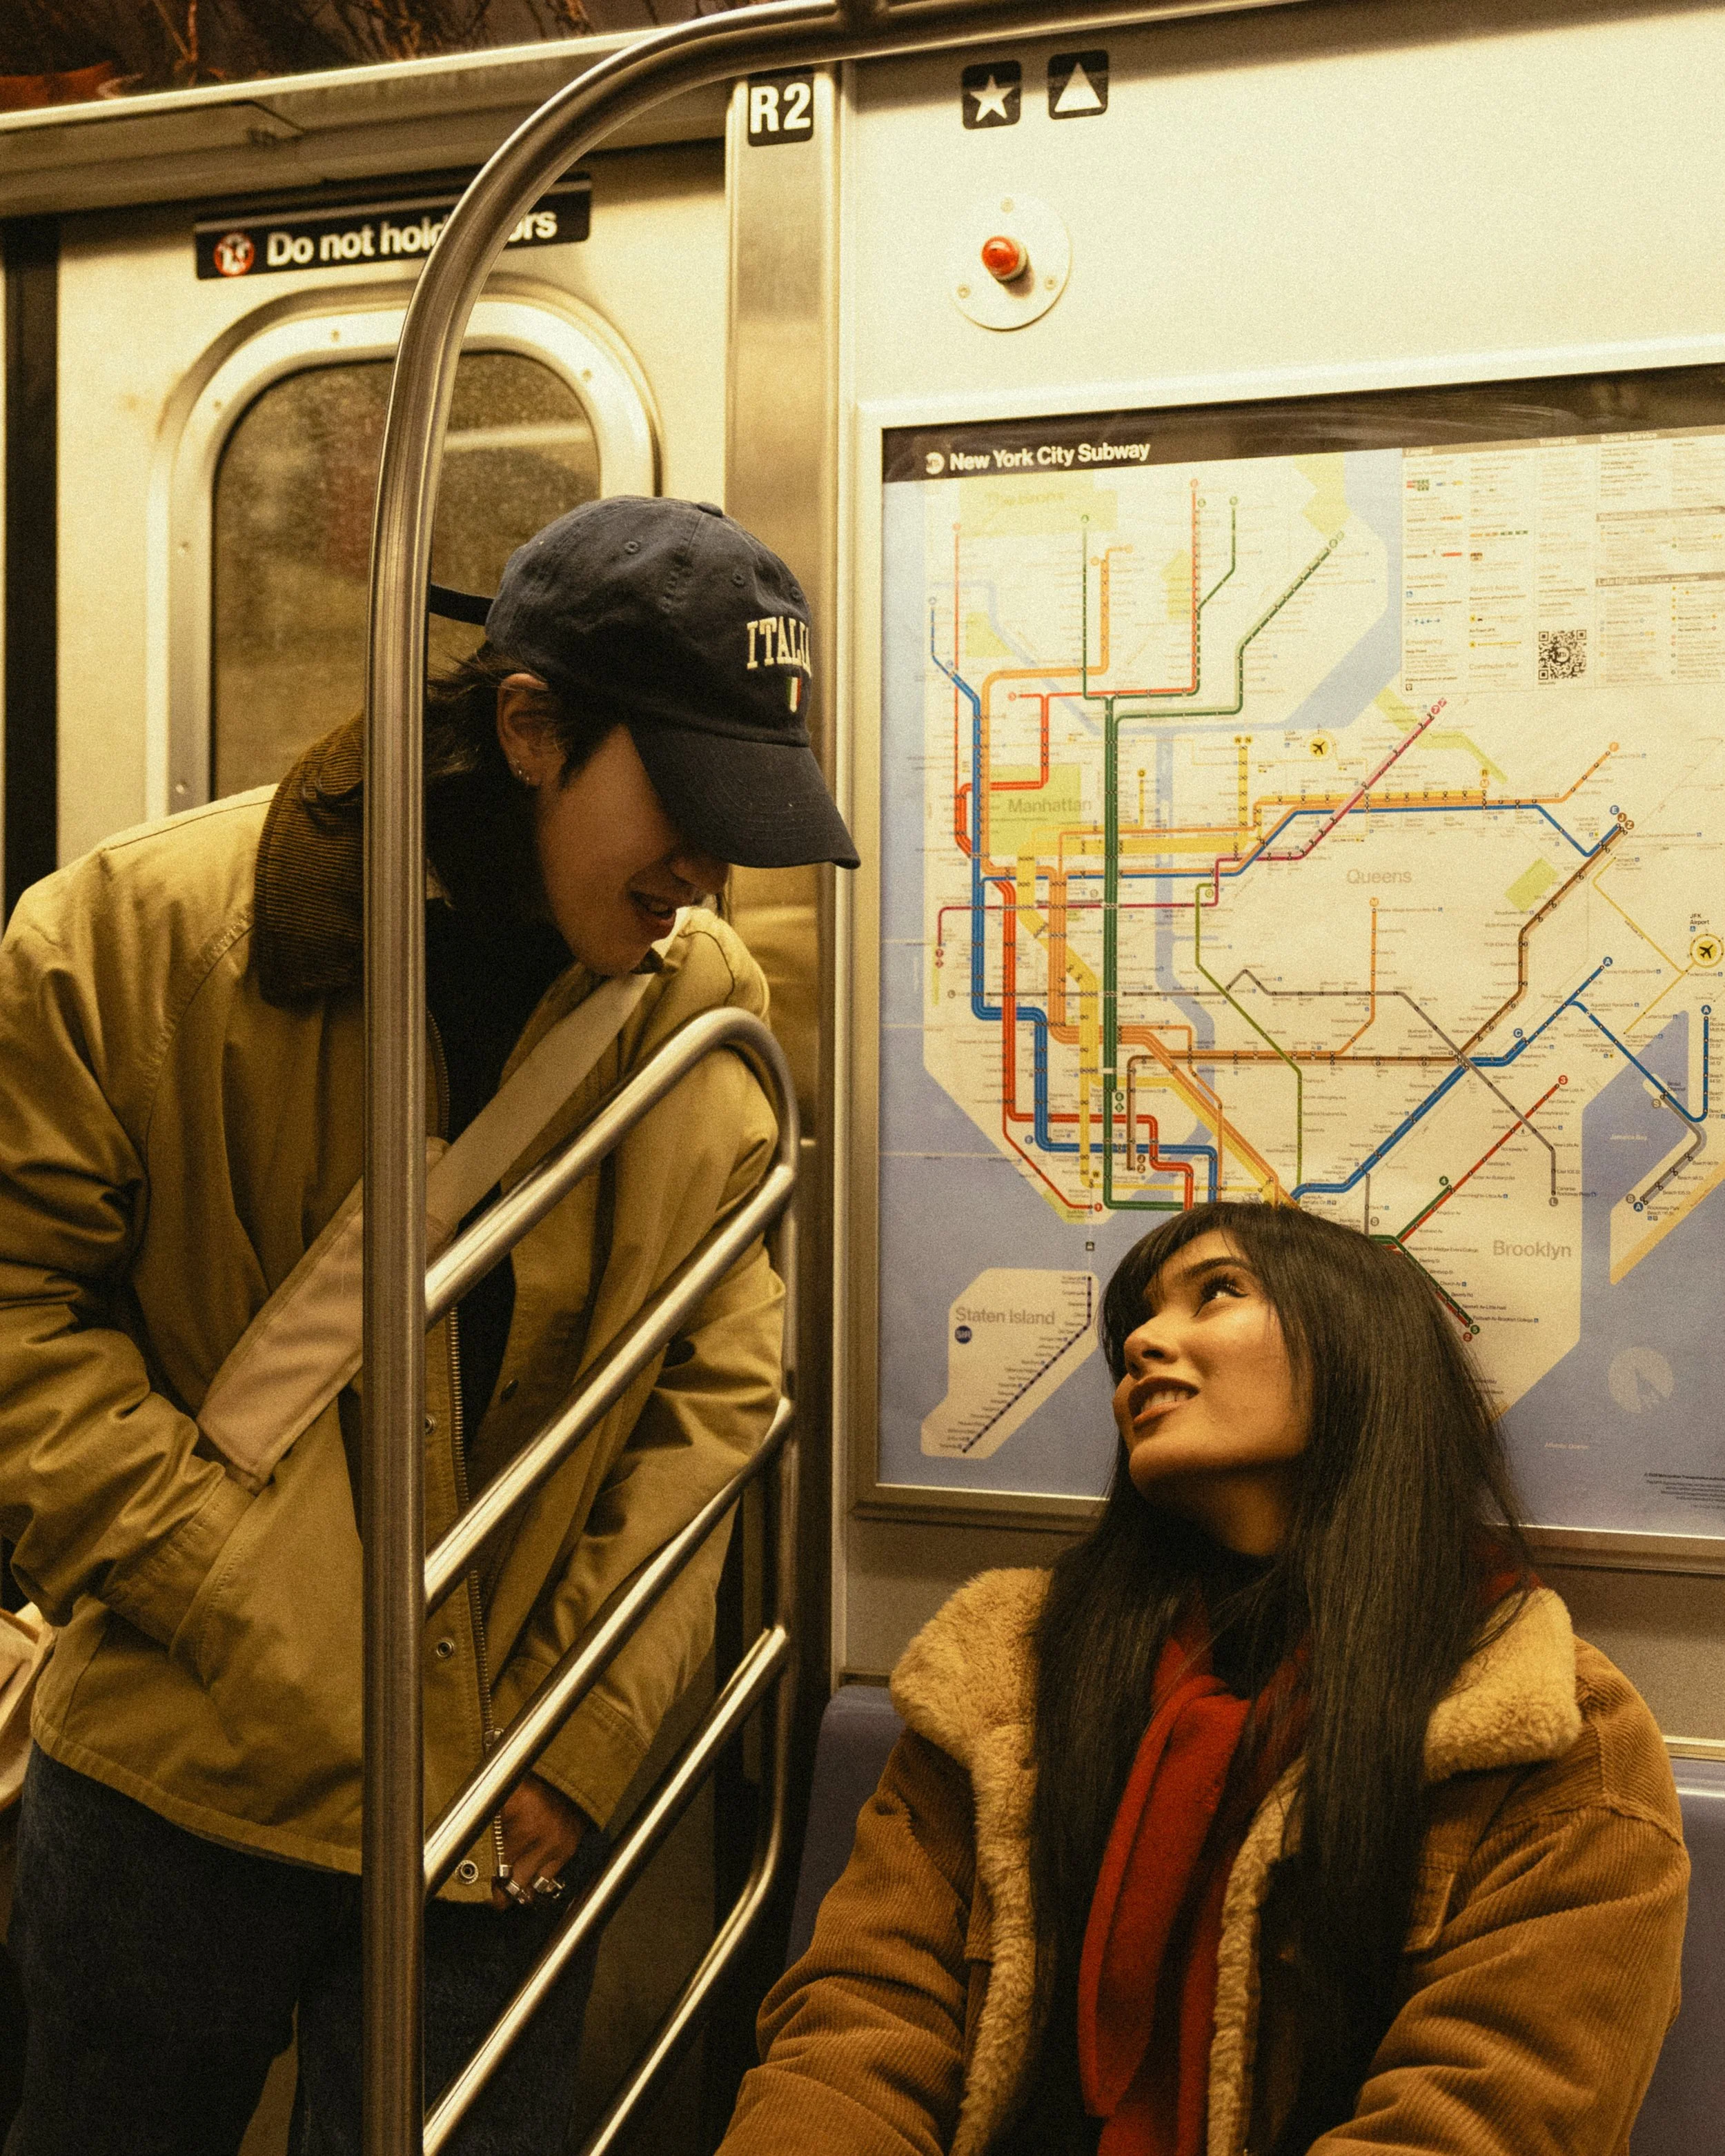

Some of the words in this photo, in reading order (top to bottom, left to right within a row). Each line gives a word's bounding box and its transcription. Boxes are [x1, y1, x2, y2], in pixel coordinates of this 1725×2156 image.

[750, 83, 811, 135] R2
[267, 231, 315, 267] Do
[319, 224, 375, 261] not
[949, 453, 991, 471] New
[992, 448, 1034, 468] York
[1036, 445, 1075, 468] City
[1078, 442, 1151, 463] Subway
[1007, 798, 1092, 813] Manhattan
[1347, 869, 1412, 884] Queens
[1492, 1240, 1571, 1260] Brooklyn
[955, 1306, 1005, 1323] Staten
[1009, 1309, 1055, 1325] Island
